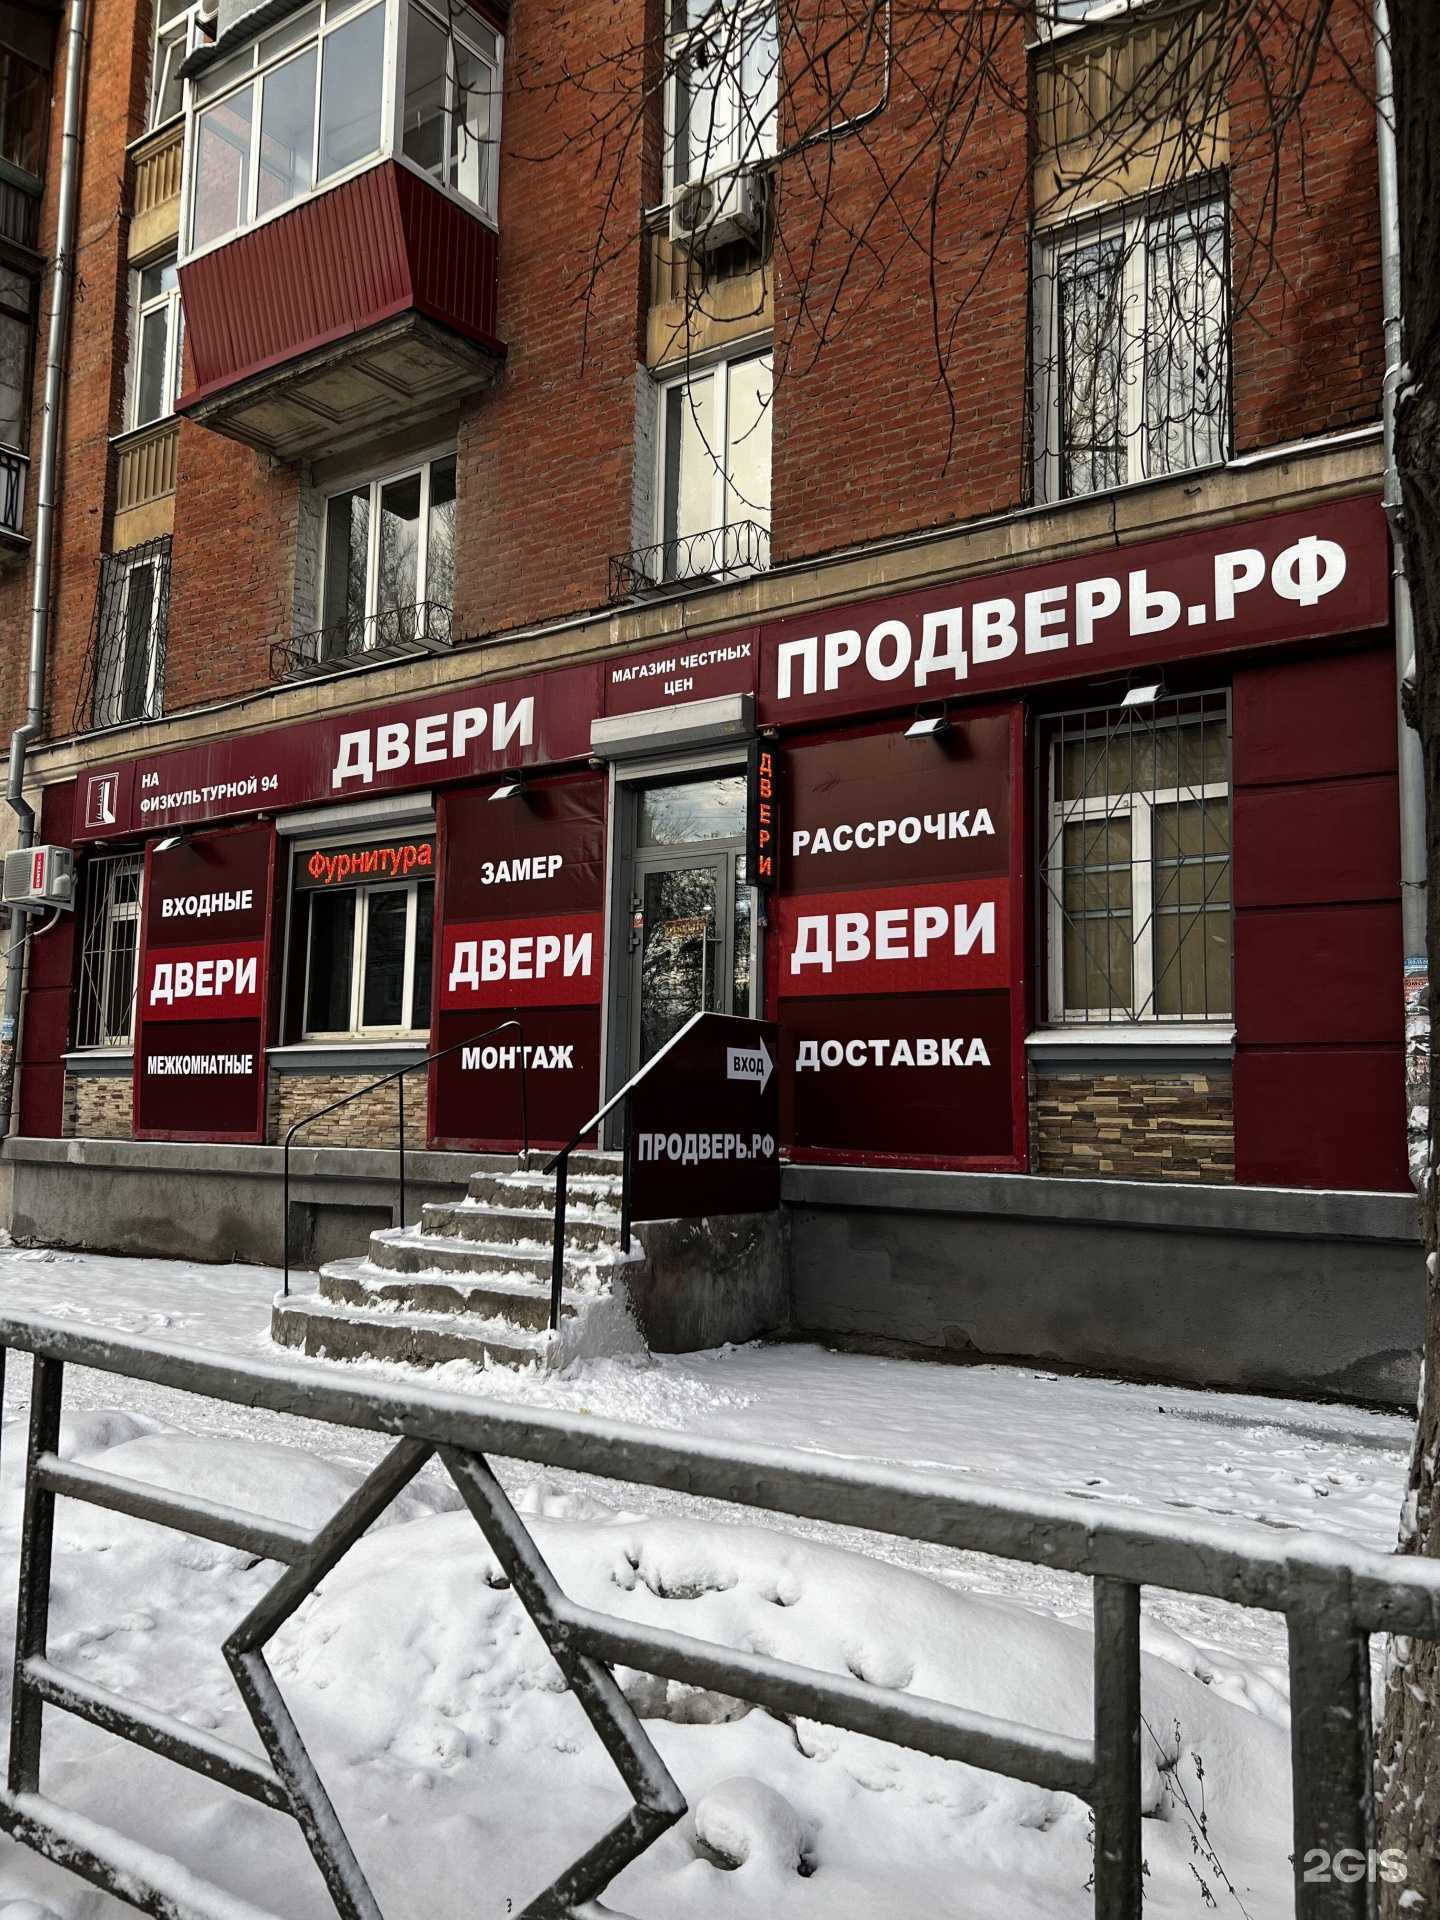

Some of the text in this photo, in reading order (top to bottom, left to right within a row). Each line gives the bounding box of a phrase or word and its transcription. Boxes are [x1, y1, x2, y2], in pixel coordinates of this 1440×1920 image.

[777, 535, 1347, 700] ПРОДВЕРЬ.РФ
[612, 643, 751, 683] МАГАЗИН ЧЕСТНЫХ
[664, 677, 693, 695] ЦЕН
[332, 696, 534, 789] ДВЕРИ
[140, 774, 279, 812] ФИЗКУЛЬТУРНОЙ 94
[142, 772, 159, 789] НА
[759, 753, 773, 877] ДВЕРИ
[792, 808, 995, 857] РАССРОЧКА
[308, 843, 432, 884] Фурнитура
[480, 855, 563, 884] ЗАМЕР
[161, 889, 253, 918] ВХОДНЫЕ
[791, 902, 995, 975] ДВЕРИ
[150, 957, 257, 1006] ДВЕРИ
[449, 933, 593, 992] ДВЕРИ
[147, 1054, 253, 1075] МЕЖКОМНАТНЫЕ
[461, 1045, 574, 1069] МОНТАЖ
[733, 1056, 765, 1076] ВХОД
[795, 1038, 991, 1072] ДОСТАВКА
[638, 1132, 775, 1165] ПРОДВЕРЬ.РФ
